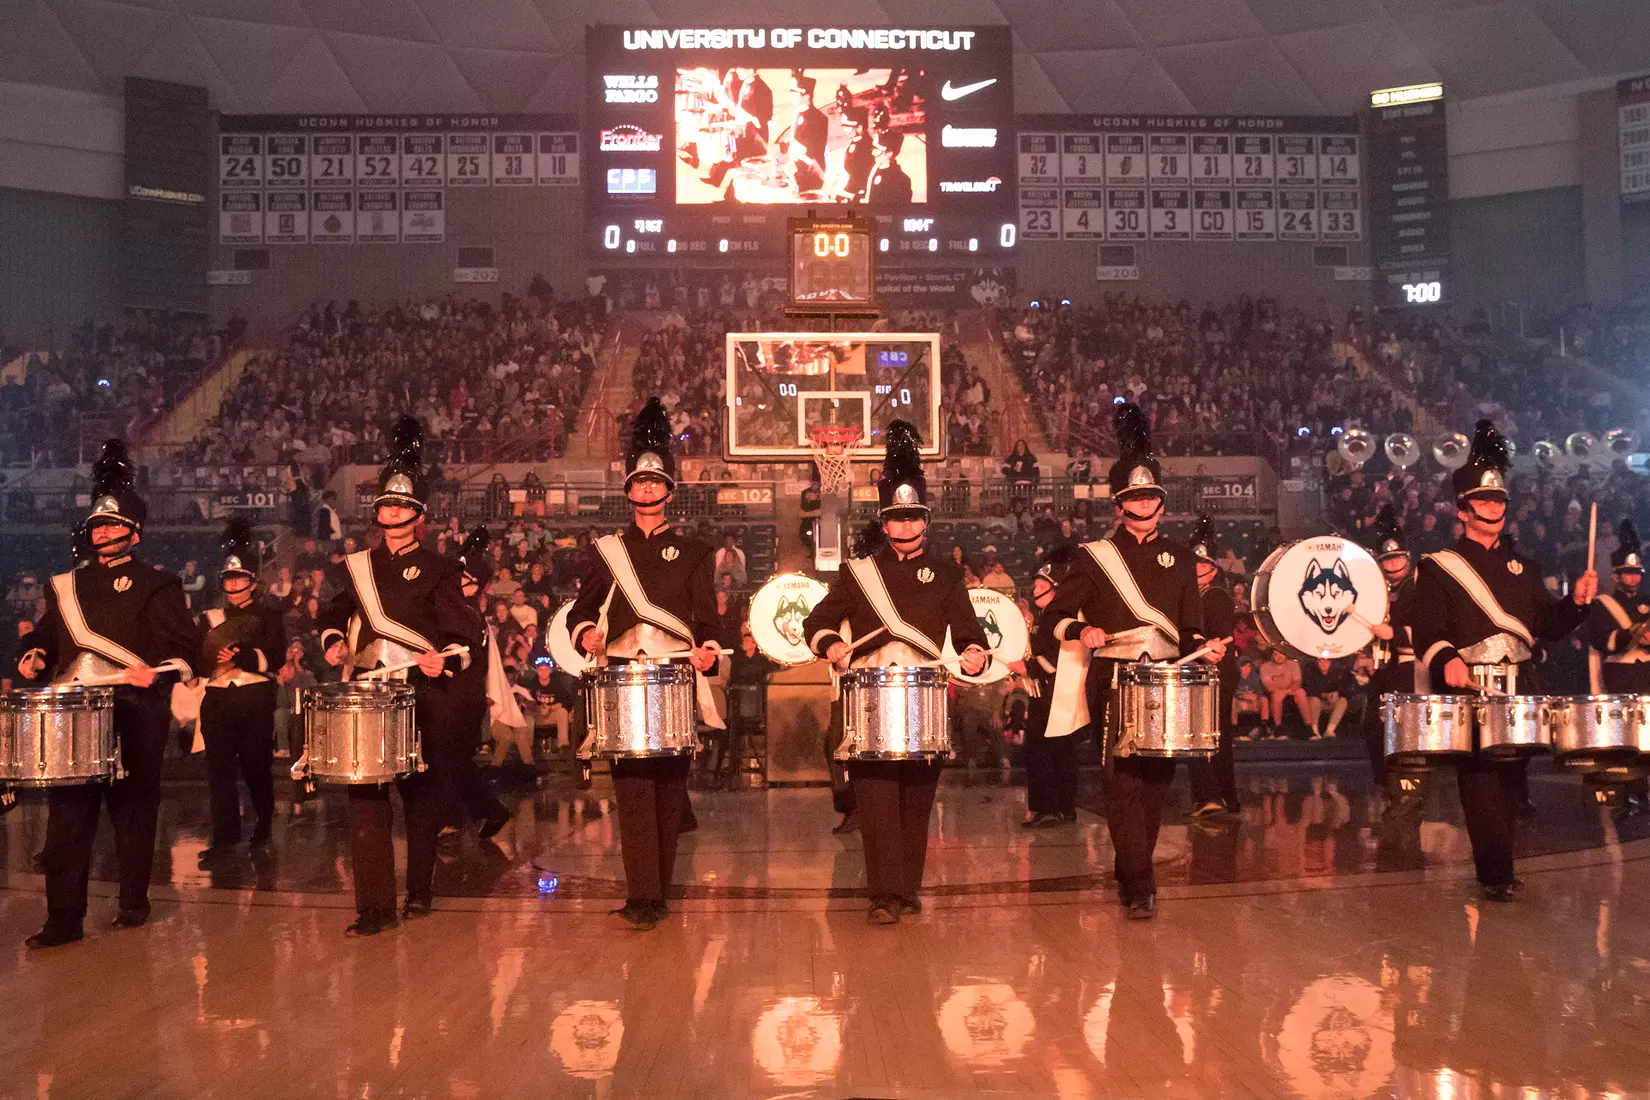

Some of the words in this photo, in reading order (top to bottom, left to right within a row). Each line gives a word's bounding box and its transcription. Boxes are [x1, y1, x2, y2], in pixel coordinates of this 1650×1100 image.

[623, 28, 765, 50] UNIVERSITY
[770, 28, 802, 49] OF
[807, 28, 975, 50] CONNECTICUT
[603, 75, 658, 89] WELLS
[605, 89, 658, 103] FARGO
[299, 118, 348, 127] UCONN
[426, 118, 443, 127] OF
[451, 118, 499, 127] HONOR
[1093, 118, 1140, 127] UCONN
[1147, 118, 1207, 128] HUSKIES
[1214, 119, 1230, 128] OF
[1238, 119, 1284, 128] HONOR
[600, 129, 663, 146] Frontier
[226, 157, 256, 177] 24
[271, 157, 301, 177] 50
[320, 157, 344, 177] 21
[364, 157, 391, 177] 52
[409, 157, 438, 177] 42
[457, 156, 480, 176] 25
[1030, 156, 1047, 176] 32
[1079, 156, 1087, 176] 3
[1286, 156, 1305, 177] 31
[1330, 156, 1348, 177] 14
[1027, 211, 1053, 230] 23
[1077, 211, 1089, 230] 4
[1115, 211, 1139, 230] 30
[1164, 211, 1177, 230] 3
[1200, 211, 1225, 231] CD
[1247, 211, 1264, 231] 15
[1283, 212, 1312, 231] 24
[1328, 212, 1354, 231] 33
[605, 225, 620, 249] 0
[880, 238, 889, 251] 0
[929, 238, 938, 251] 0
[969, 238, 978, 251] 0
[1000, 223, 1016, 247] 0
[627, 239, 636, 253] 0
[667, 239, 677, 252] 0
[719, 239, 729, 252] 0
[884, 272, 917, 282] Pavilion
[954, 272, 966, 281] CT
[914, 284, 928, 293] the
[929, 284, 955, 293] World
[1402, 282, 1441, 303] 7:00
[360, 494, 377, 503] SE
[718, 491, 737, 501] SEC
[741, 489, 772, 503] 102
[1202, 486, 1221, 495] SEC
[1223, 483, 1255, 497] 104
[220, 495, 240, 504] SEC
[246, 493, 274, 507] 101
[783, 581, 810, 589] YAMAHA
[971, 596, 1000, 604] YAMAHA
